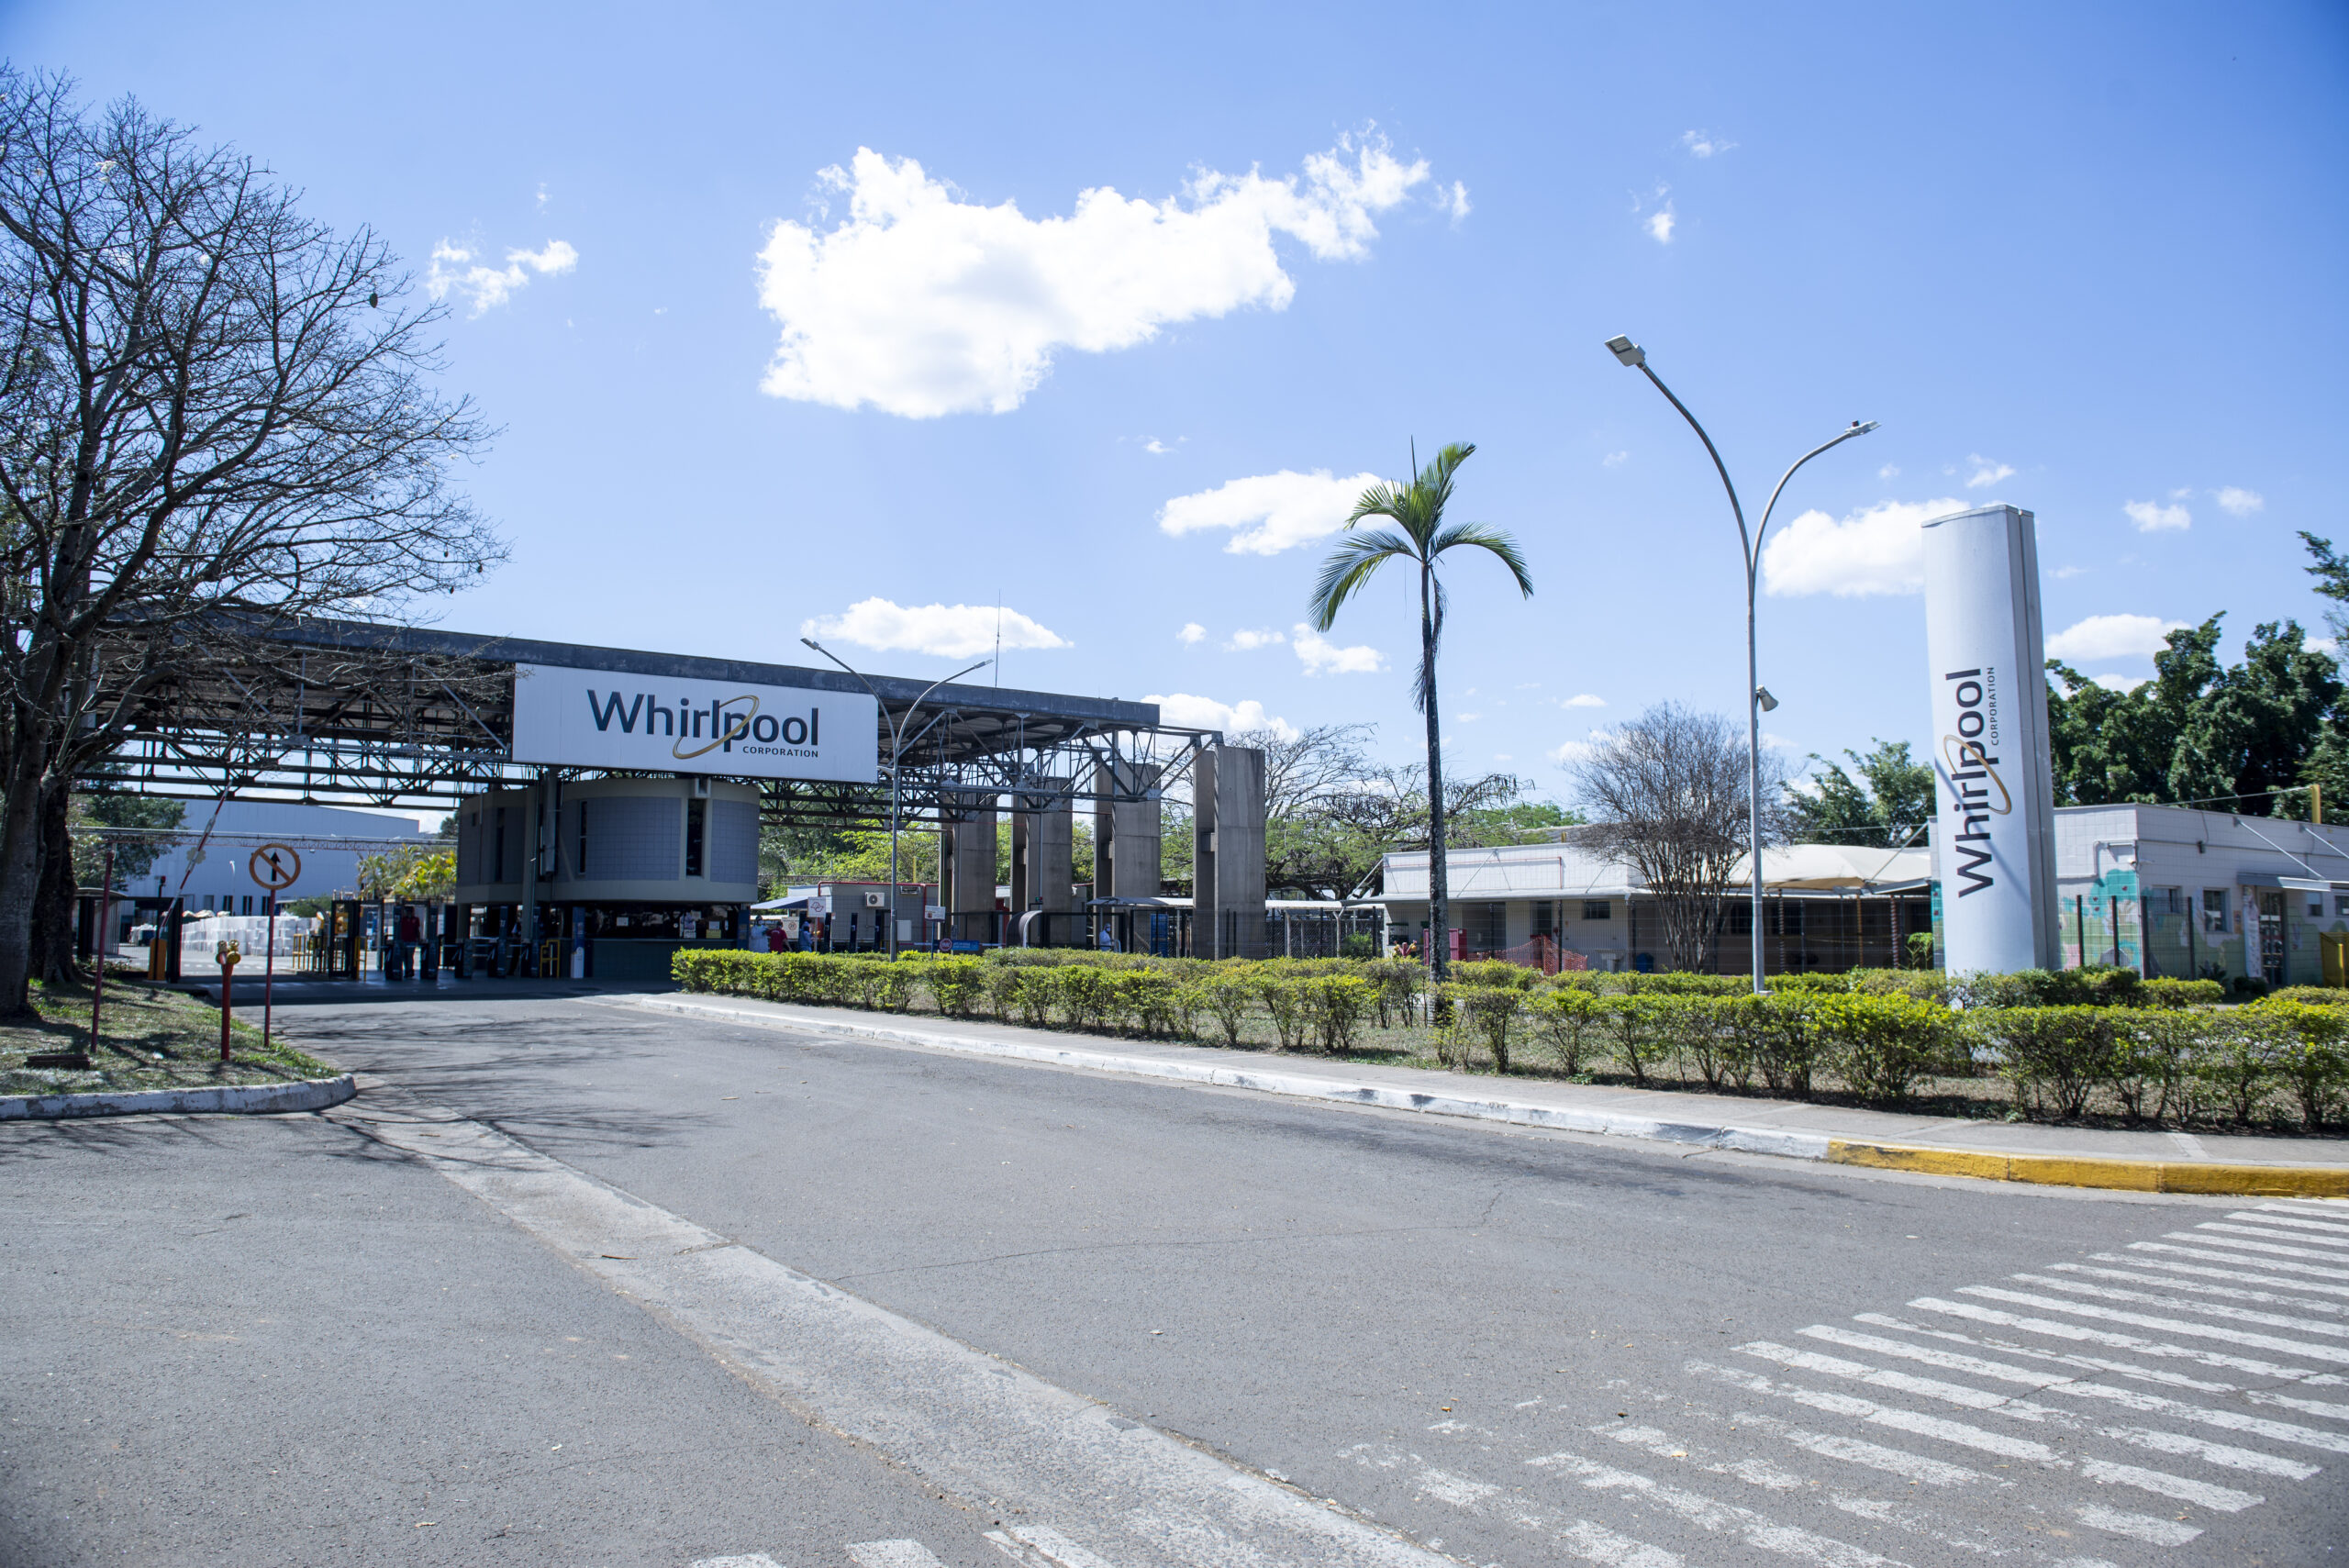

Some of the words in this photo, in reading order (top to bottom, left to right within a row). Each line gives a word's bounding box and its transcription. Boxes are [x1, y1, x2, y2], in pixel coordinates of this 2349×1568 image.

[587, 689, 818, 752] Whirlpool
[1987, 667, 1999, 746] CORPORATION
[742, 745, 818, 758] CORPORATION
[1946, 668, 1999, 898] Whirlpool
